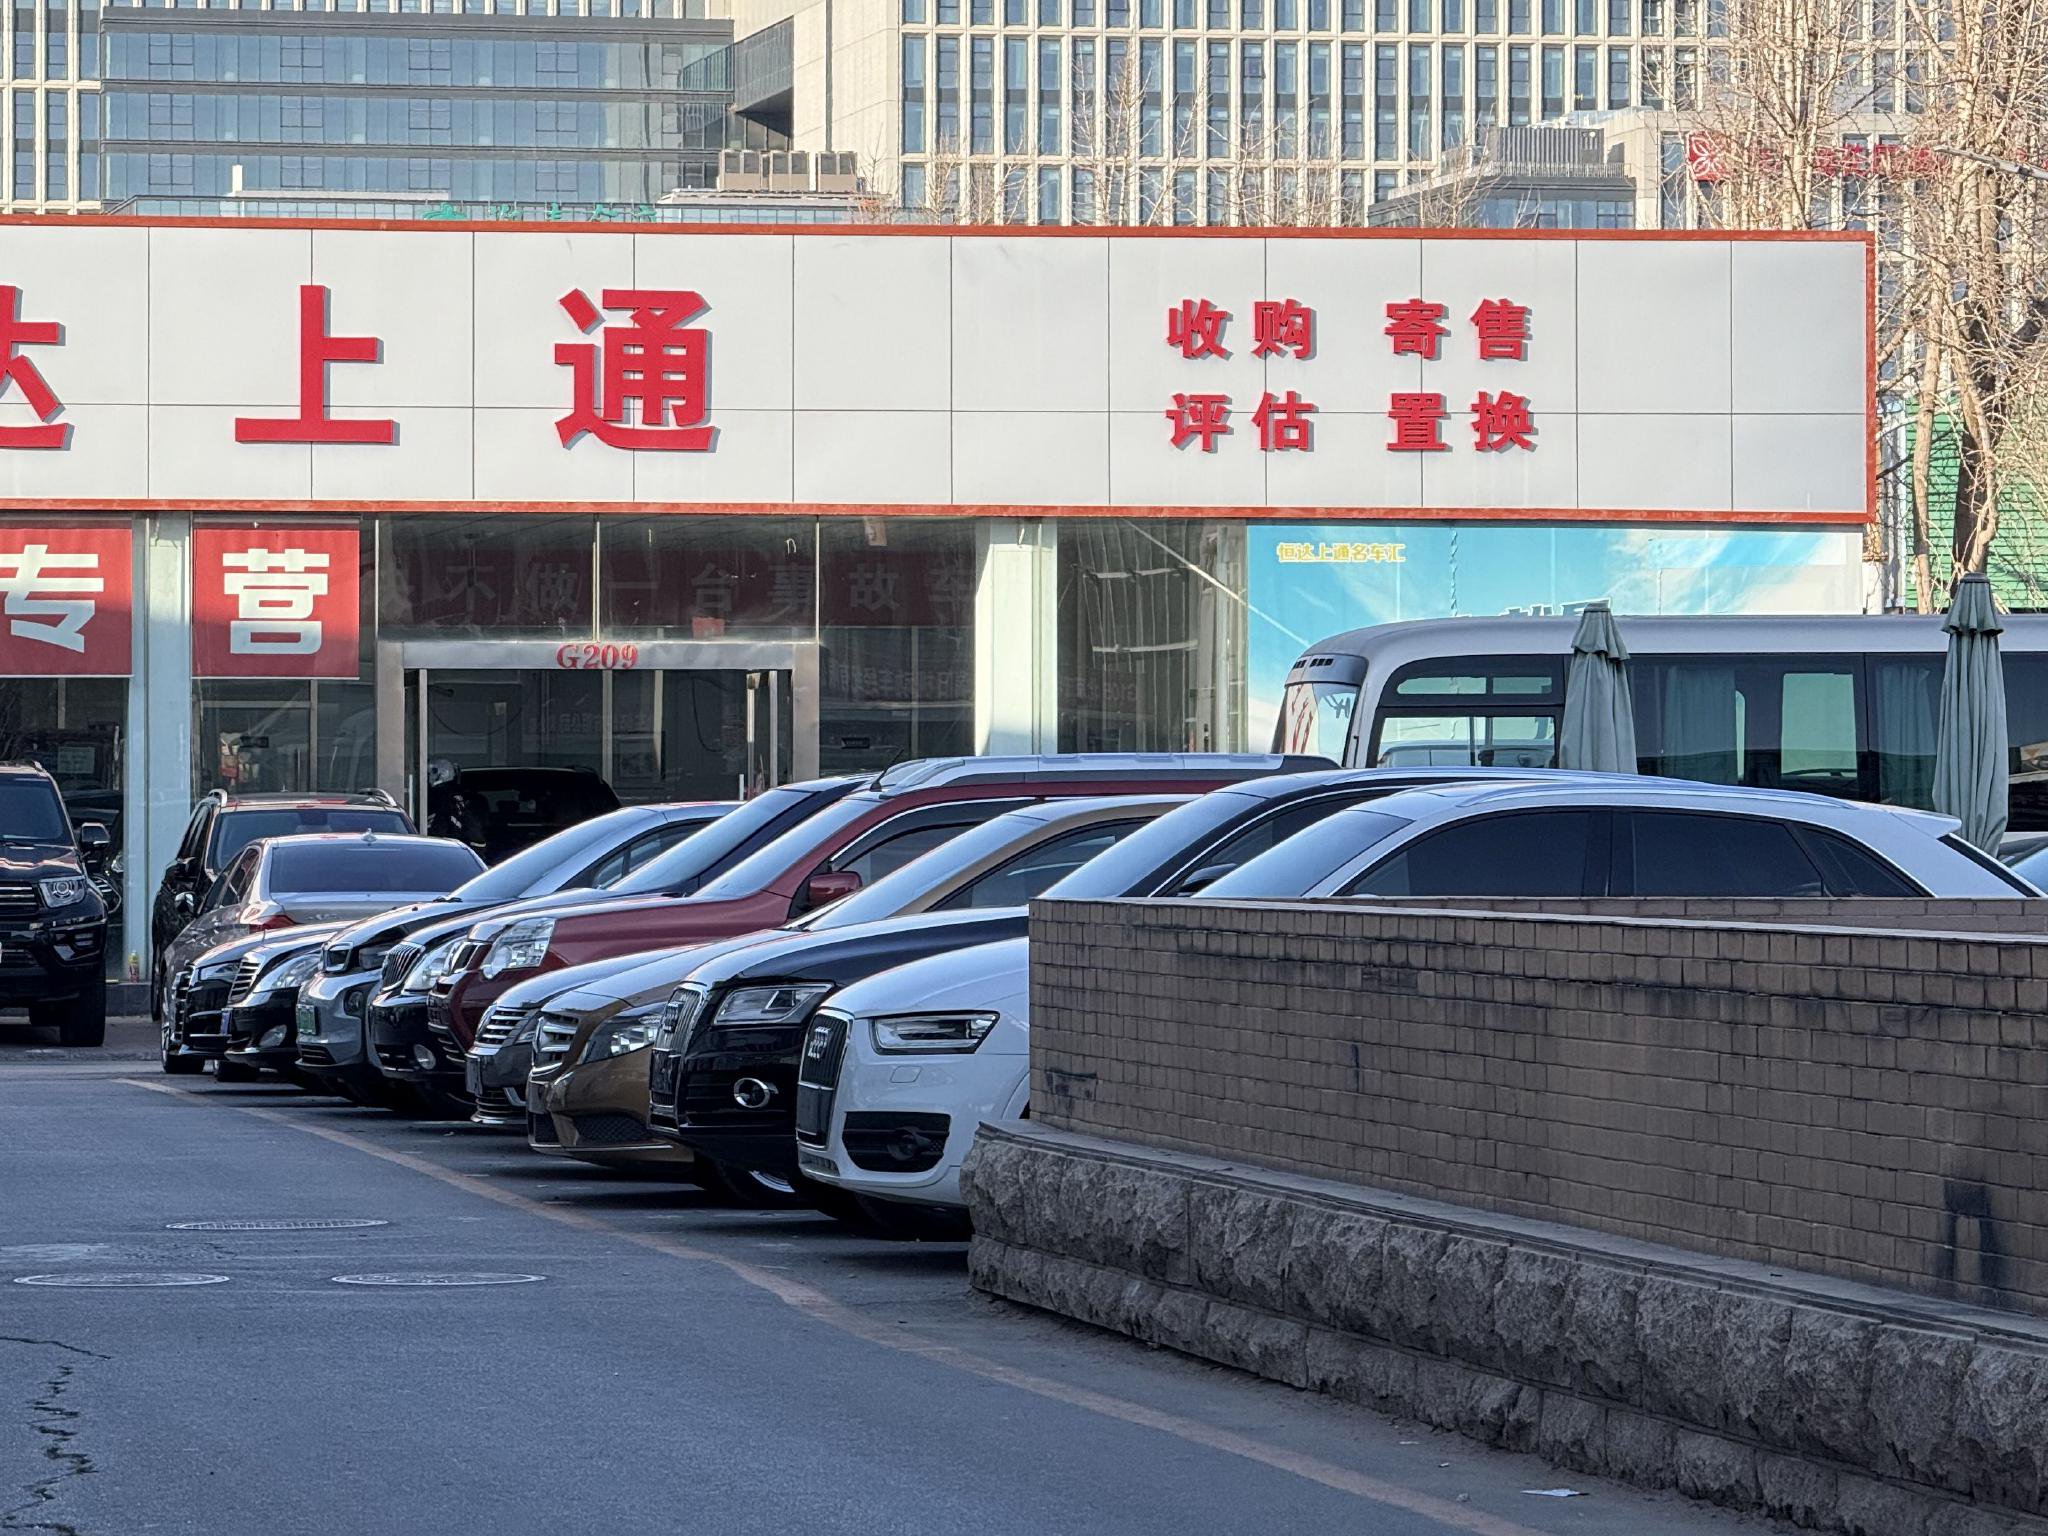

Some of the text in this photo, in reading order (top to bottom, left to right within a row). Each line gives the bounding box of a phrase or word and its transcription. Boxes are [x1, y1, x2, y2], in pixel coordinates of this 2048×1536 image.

[1168, 298, 1530, 359] 收购 寄售
[1167, 391, 1535, 452] 评估 置换
[1277, 542, 1406, 562] 恒达上通名车汇
[556, 644, 638, 669] G209
